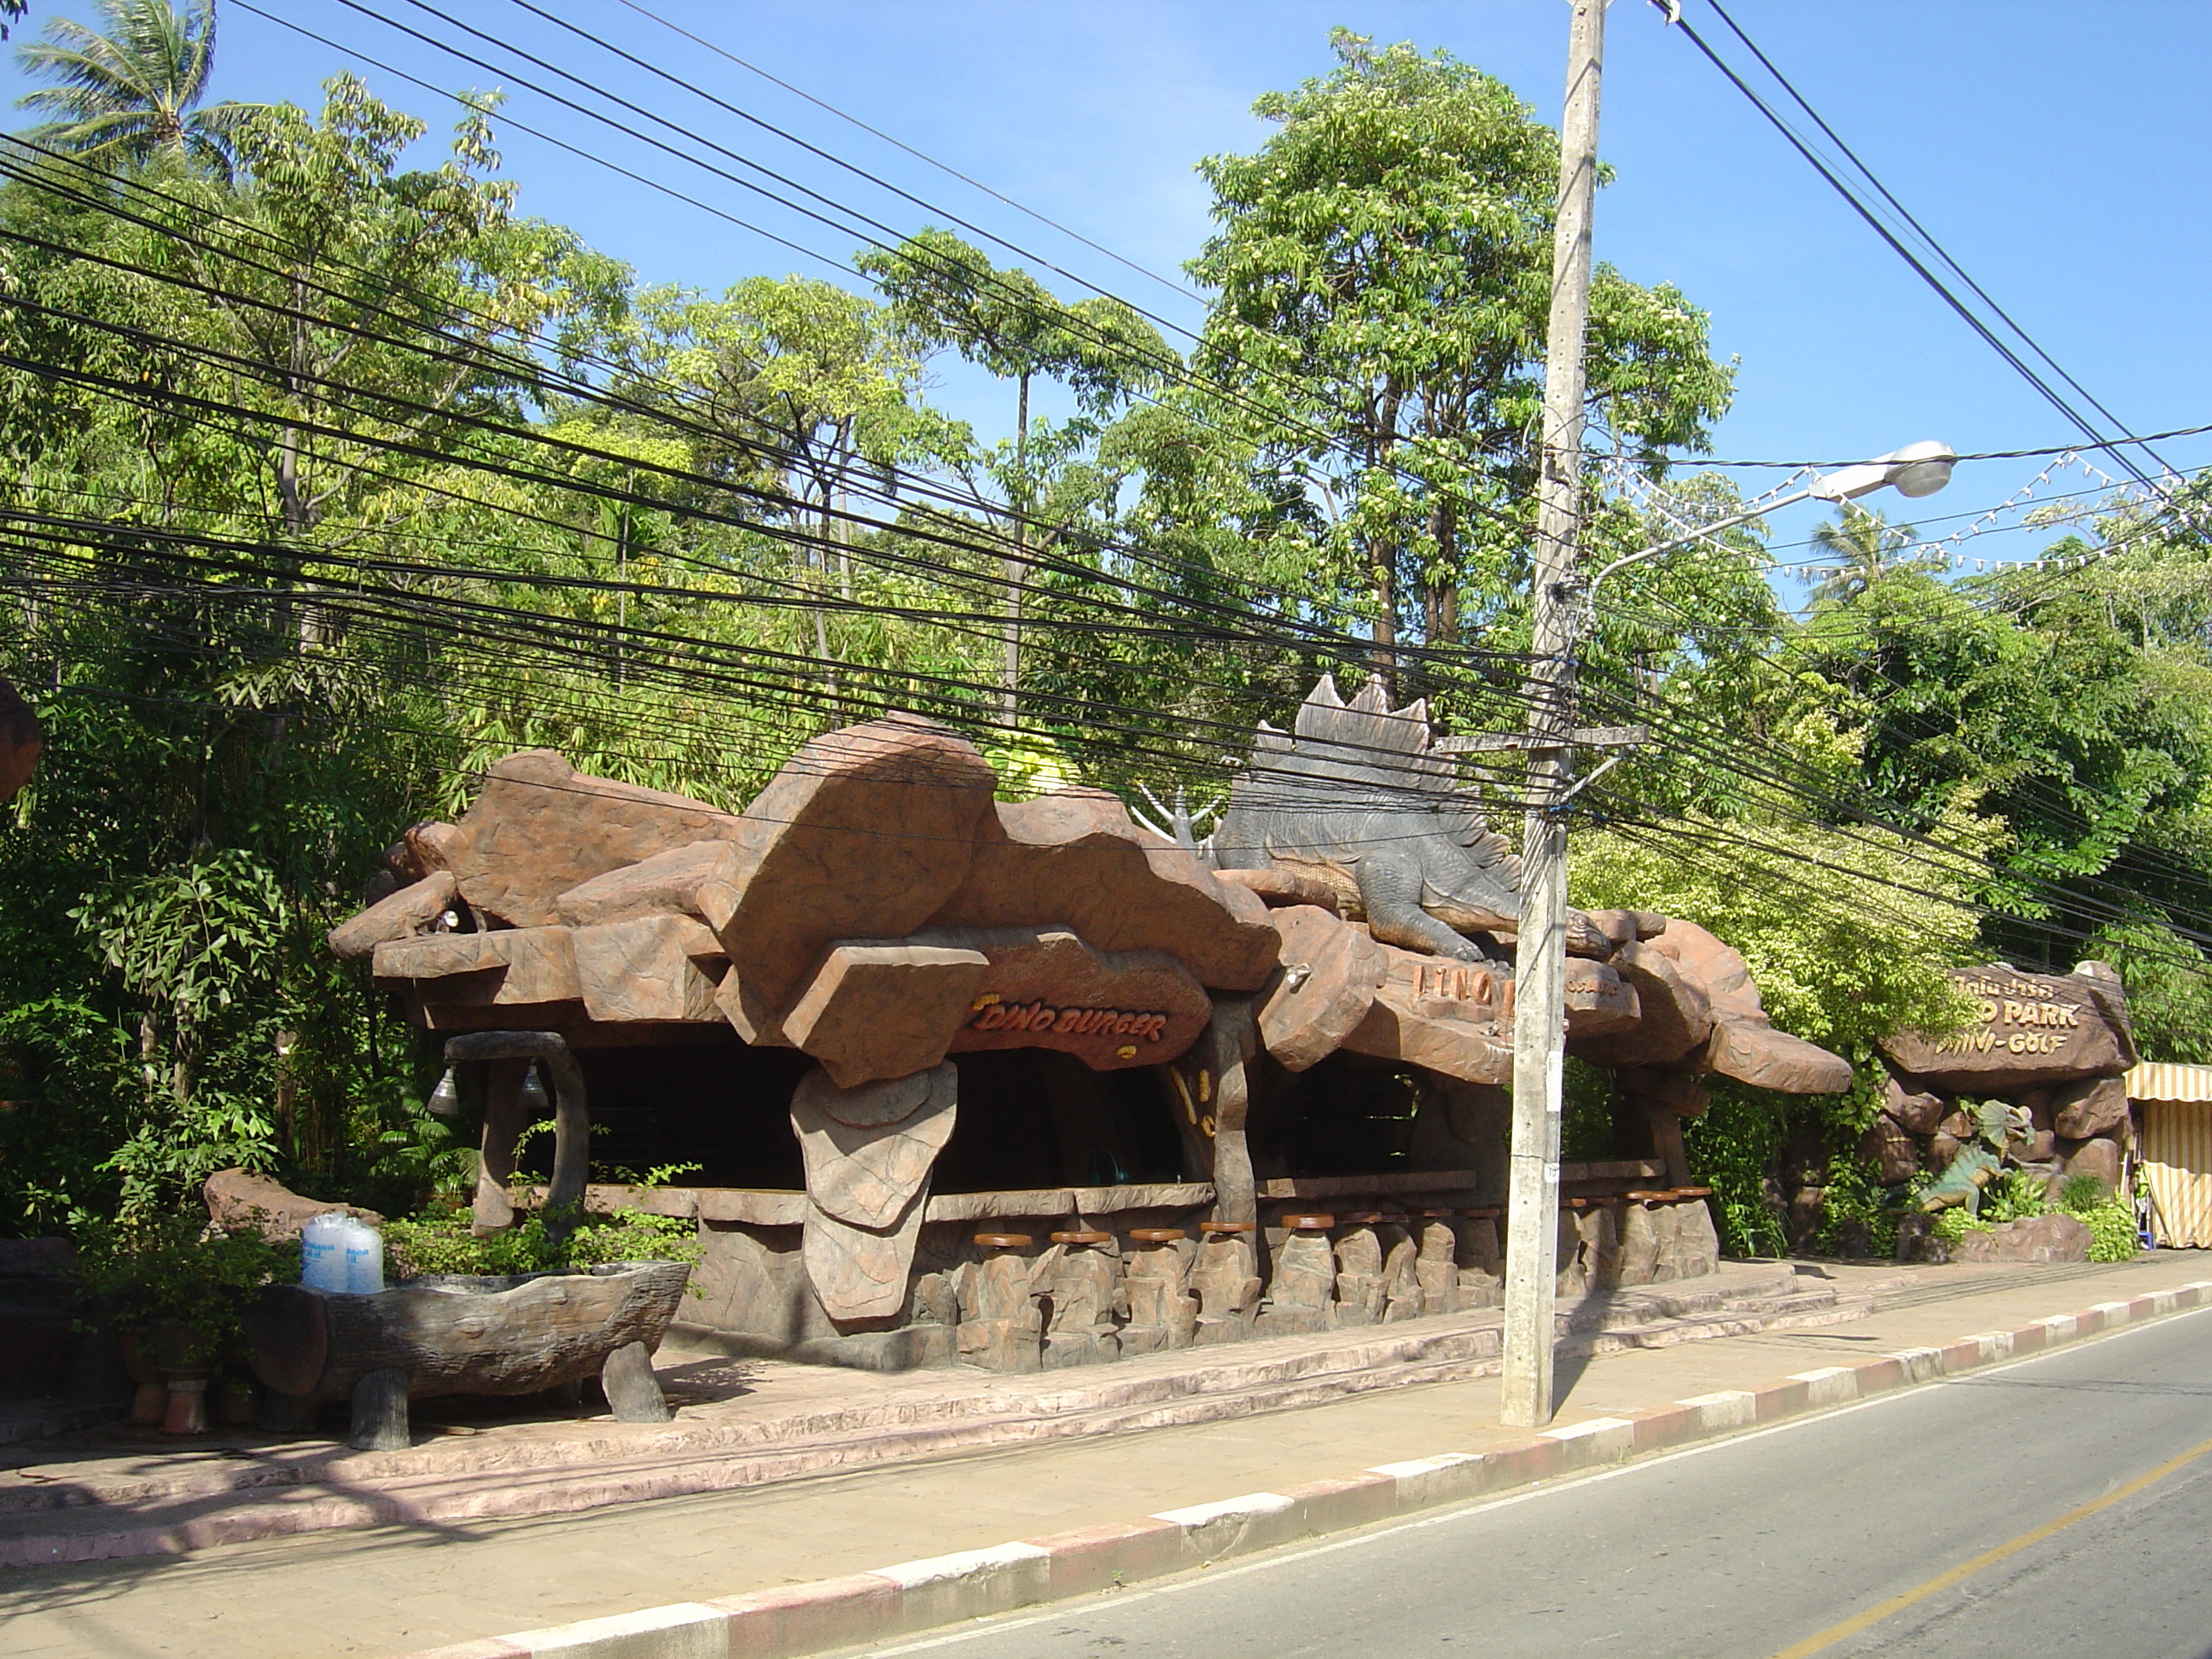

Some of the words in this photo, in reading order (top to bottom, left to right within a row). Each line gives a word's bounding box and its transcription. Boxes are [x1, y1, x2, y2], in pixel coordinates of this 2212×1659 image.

[973, 1000, 1057, 1032] DINO
[1052, 1008, 1167, 1041] BURGER
[2004, 1000, 2081, 1027] PARK
